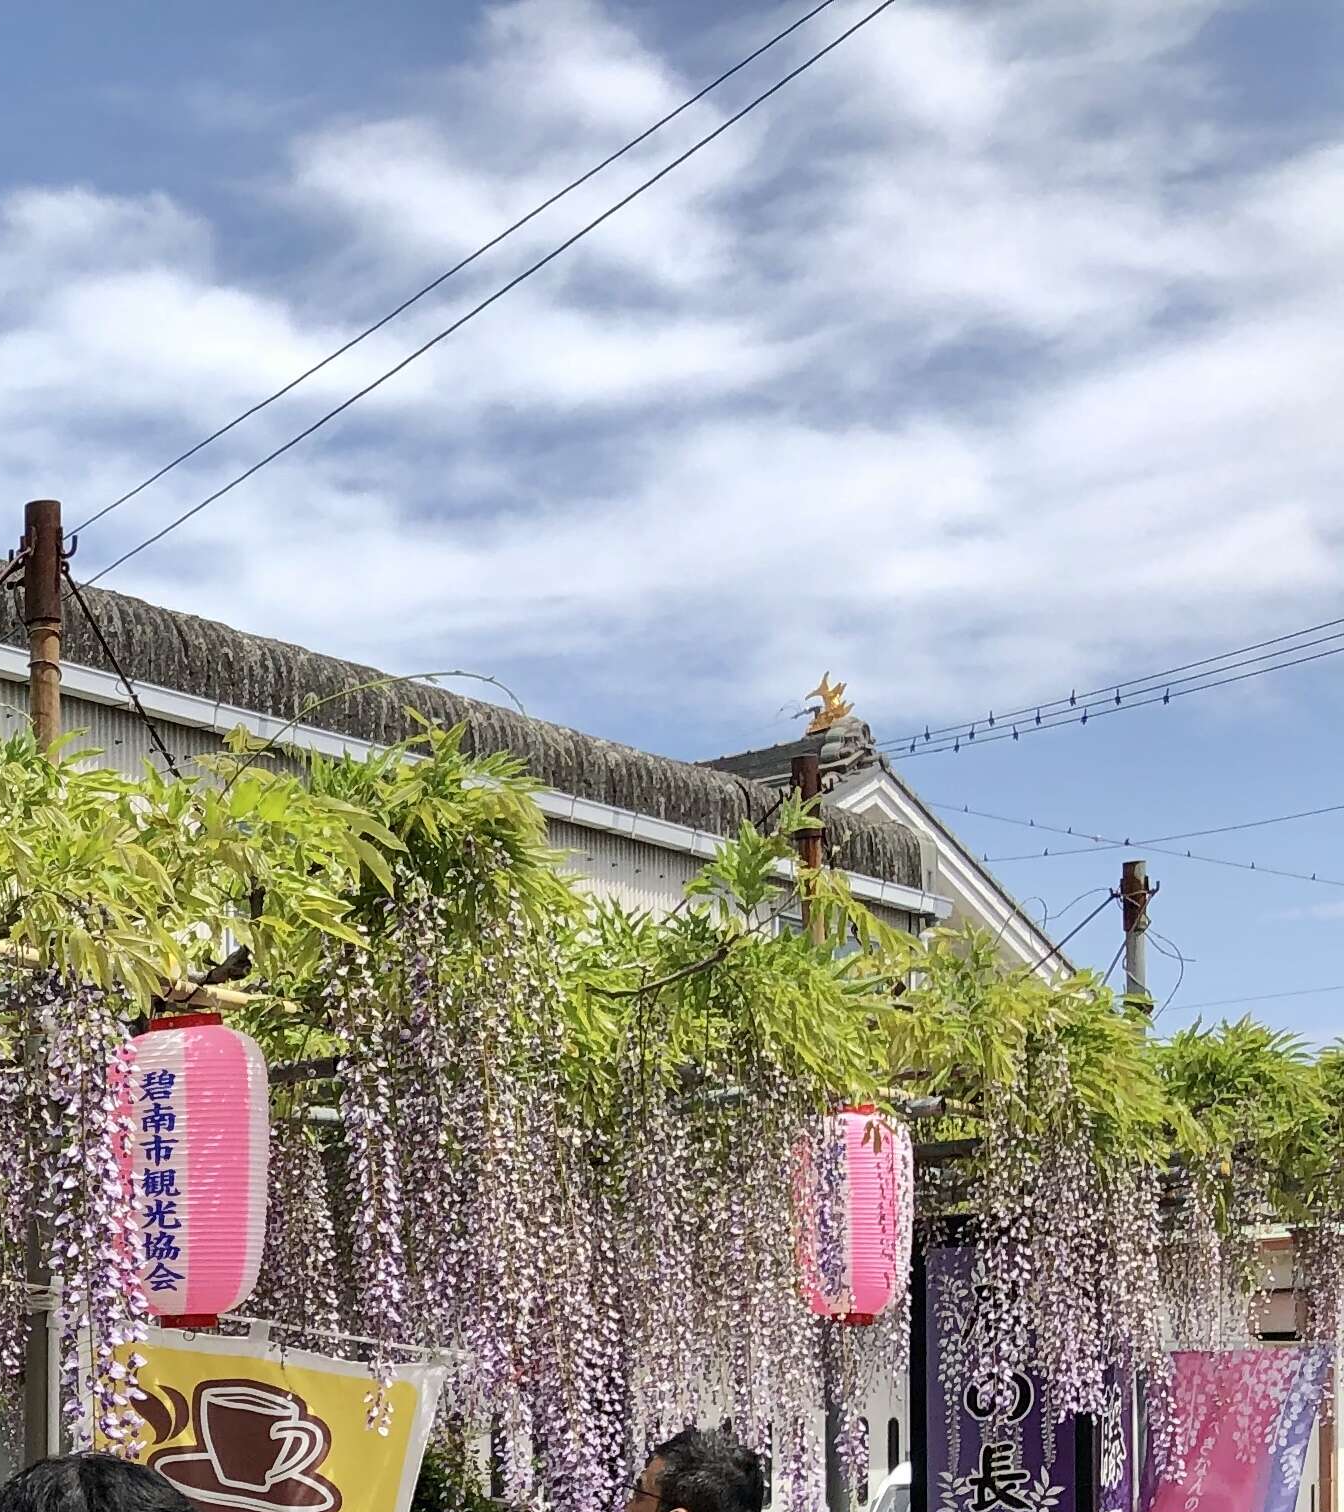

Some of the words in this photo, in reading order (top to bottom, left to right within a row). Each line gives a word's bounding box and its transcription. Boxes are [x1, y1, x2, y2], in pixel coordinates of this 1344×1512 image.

[138, 1068, 187, 1292] 碧南市観光協会
